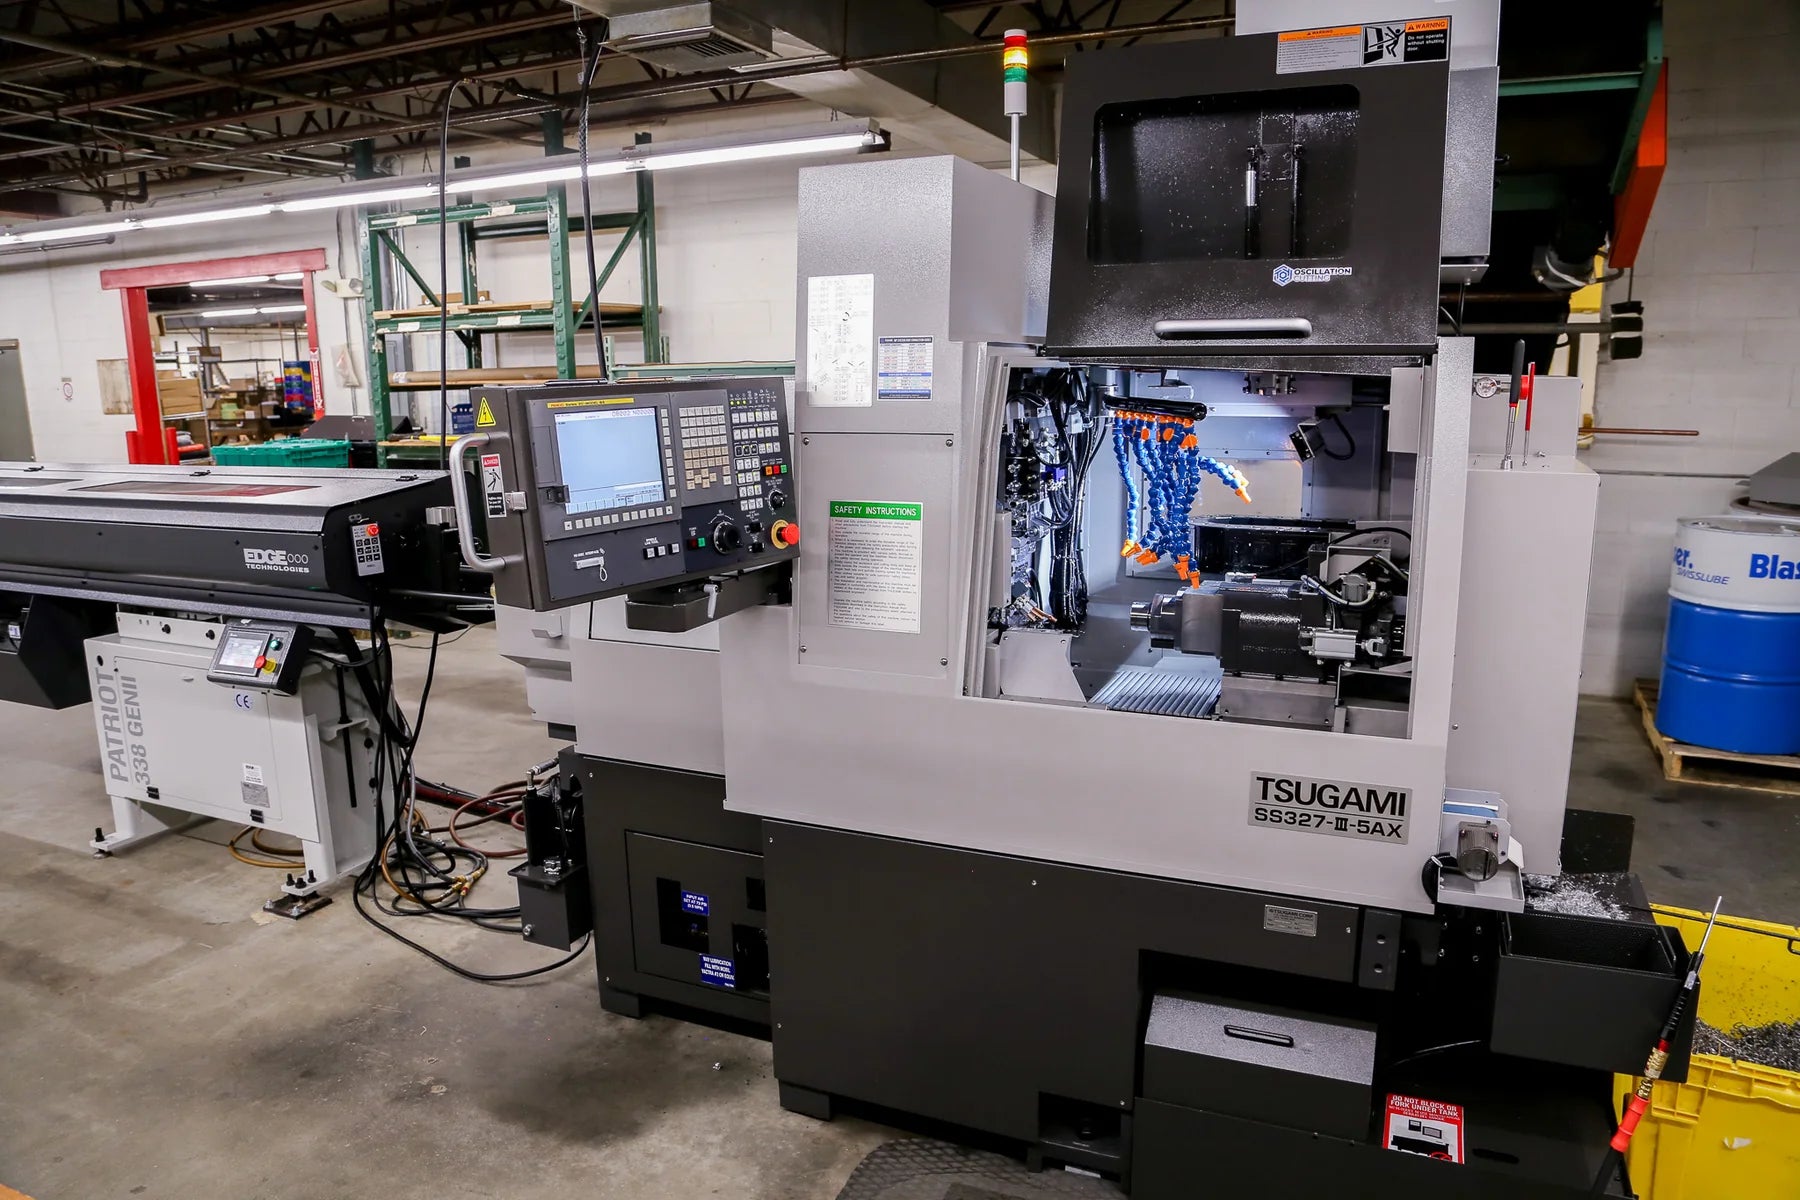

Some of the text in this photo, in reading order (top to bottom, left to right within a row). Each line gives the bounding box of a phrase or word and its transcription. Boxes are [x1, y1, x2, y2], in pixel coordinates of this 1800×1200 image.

[1415, 21, 1446, 30] WARNING
[1293, 274, 1330, 282] CUTTING
[1294, 267, 1351, 276] OSCILLATION
[834, 505, 917, 517] SAFETY INSTRUCTIONS
[243, 548, 288, 566] EDGE
[245, 562, 310, 574] TECHNOLOGIES
[1676, 567, 1730, 585] SWISSLUBE
[95, 667, 129, 783] PATRIOT
[120, 675, 151, 786] 338 GENII
[1256, 776, 1407, 817] TSUGAMI
[1390, 1100, 1410, 1108] FORK
[1411, 1103, 1437, 1114] UNDER
[1438, 1109, 1459, 1118] TANK
[1404, 1096, 1419, 1105] NOT
[1420, 1099, 1445, 1110] BLOCK
